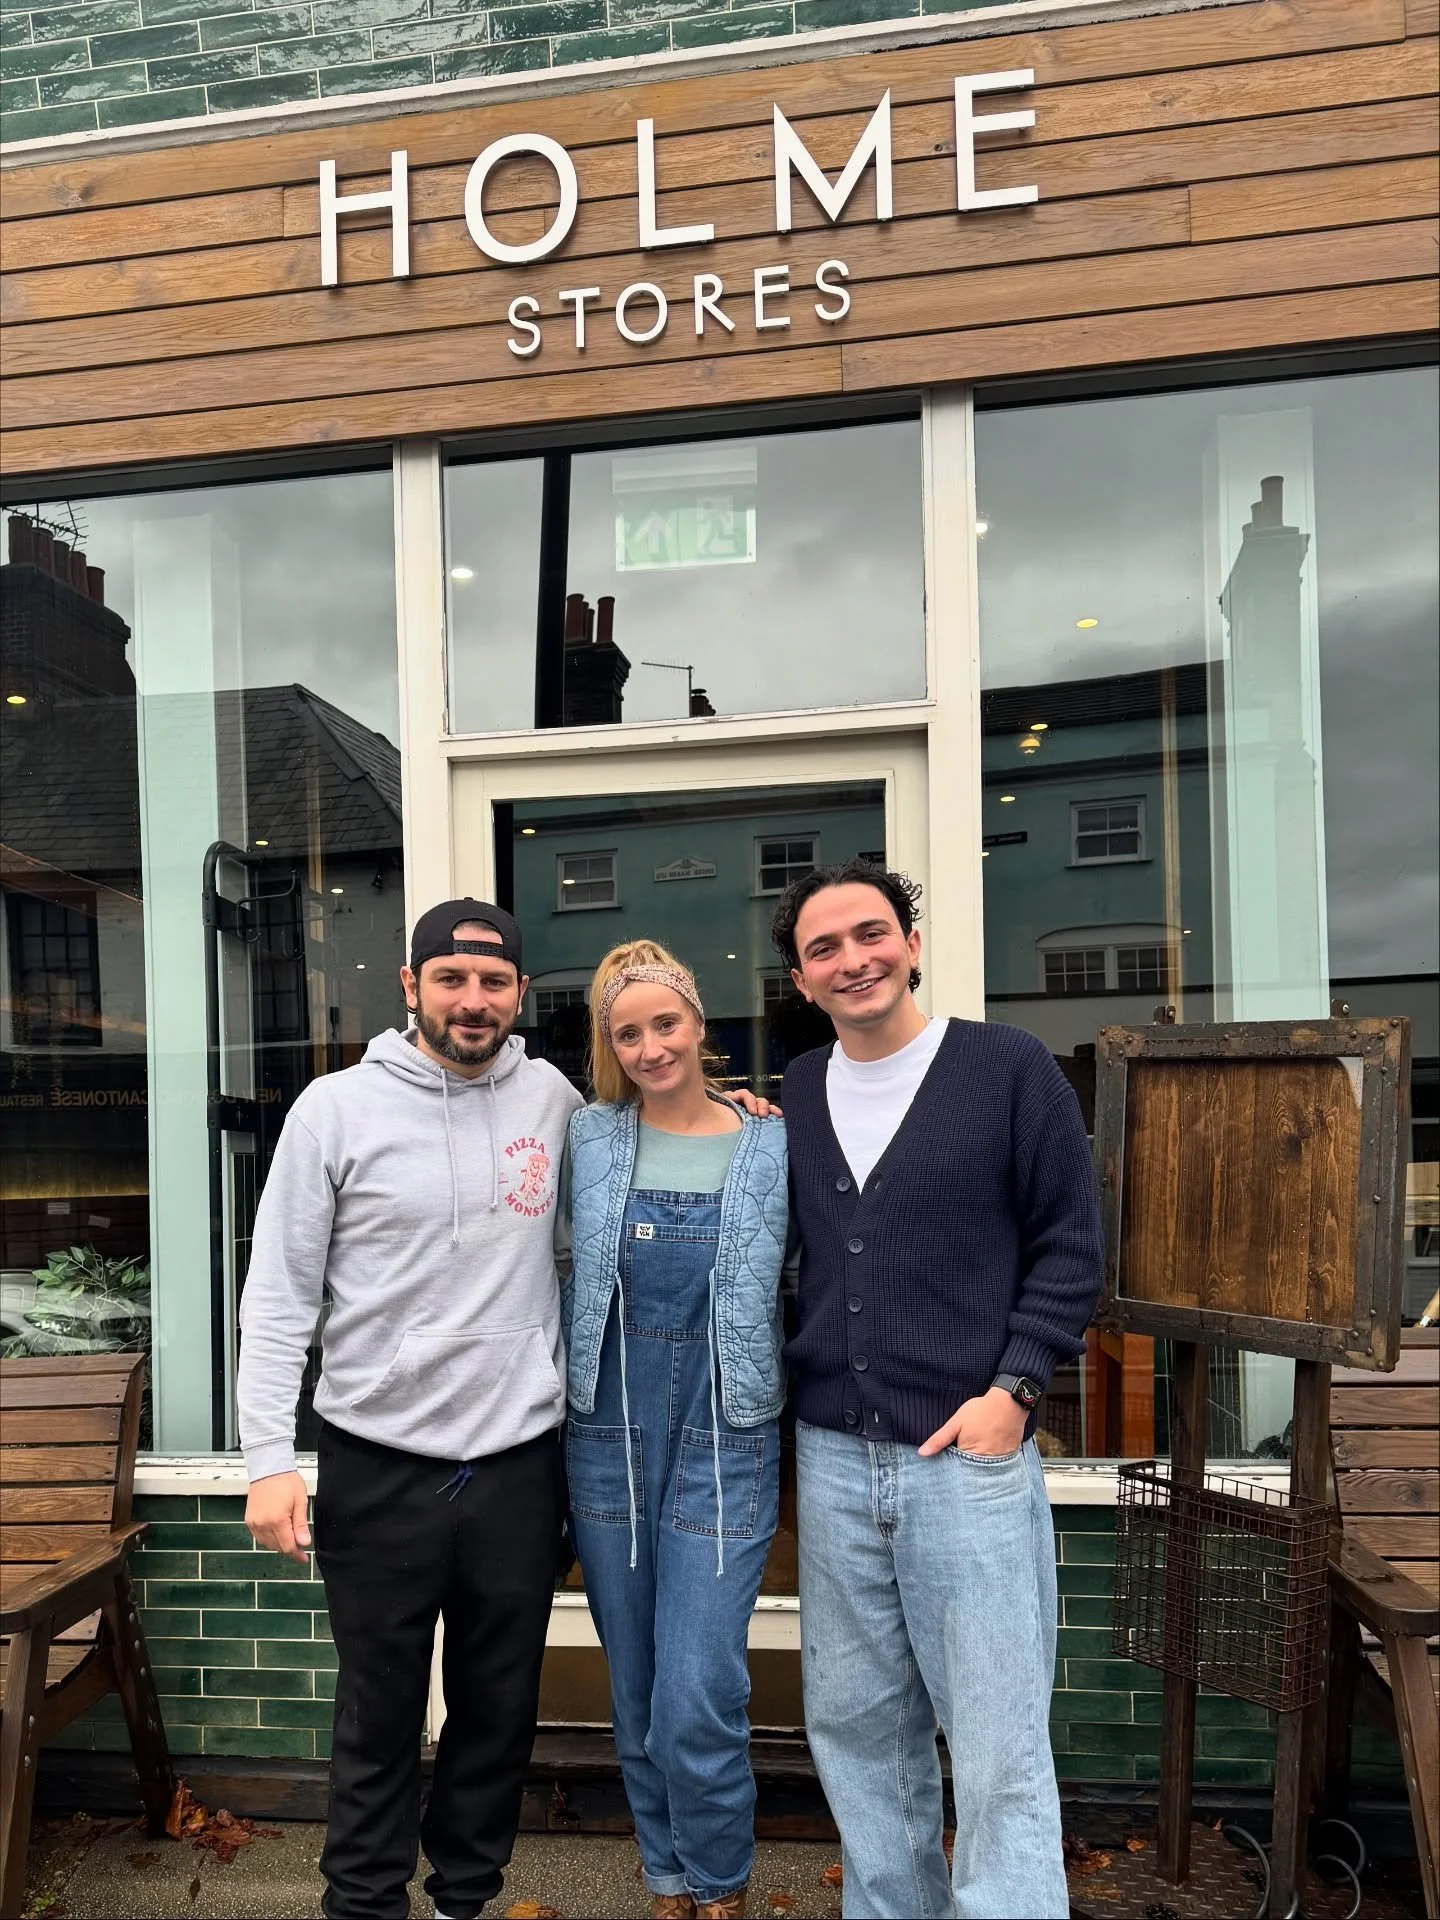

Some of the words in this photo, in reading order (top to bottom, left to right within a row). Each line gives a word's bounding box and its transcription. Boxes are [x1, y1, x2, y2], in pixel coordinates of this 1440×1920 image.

[319, 68, 1039, 286] HOLME
[507, 259, 851, 356] STORES
[505, 1137, 546, 1158] PIZZA
